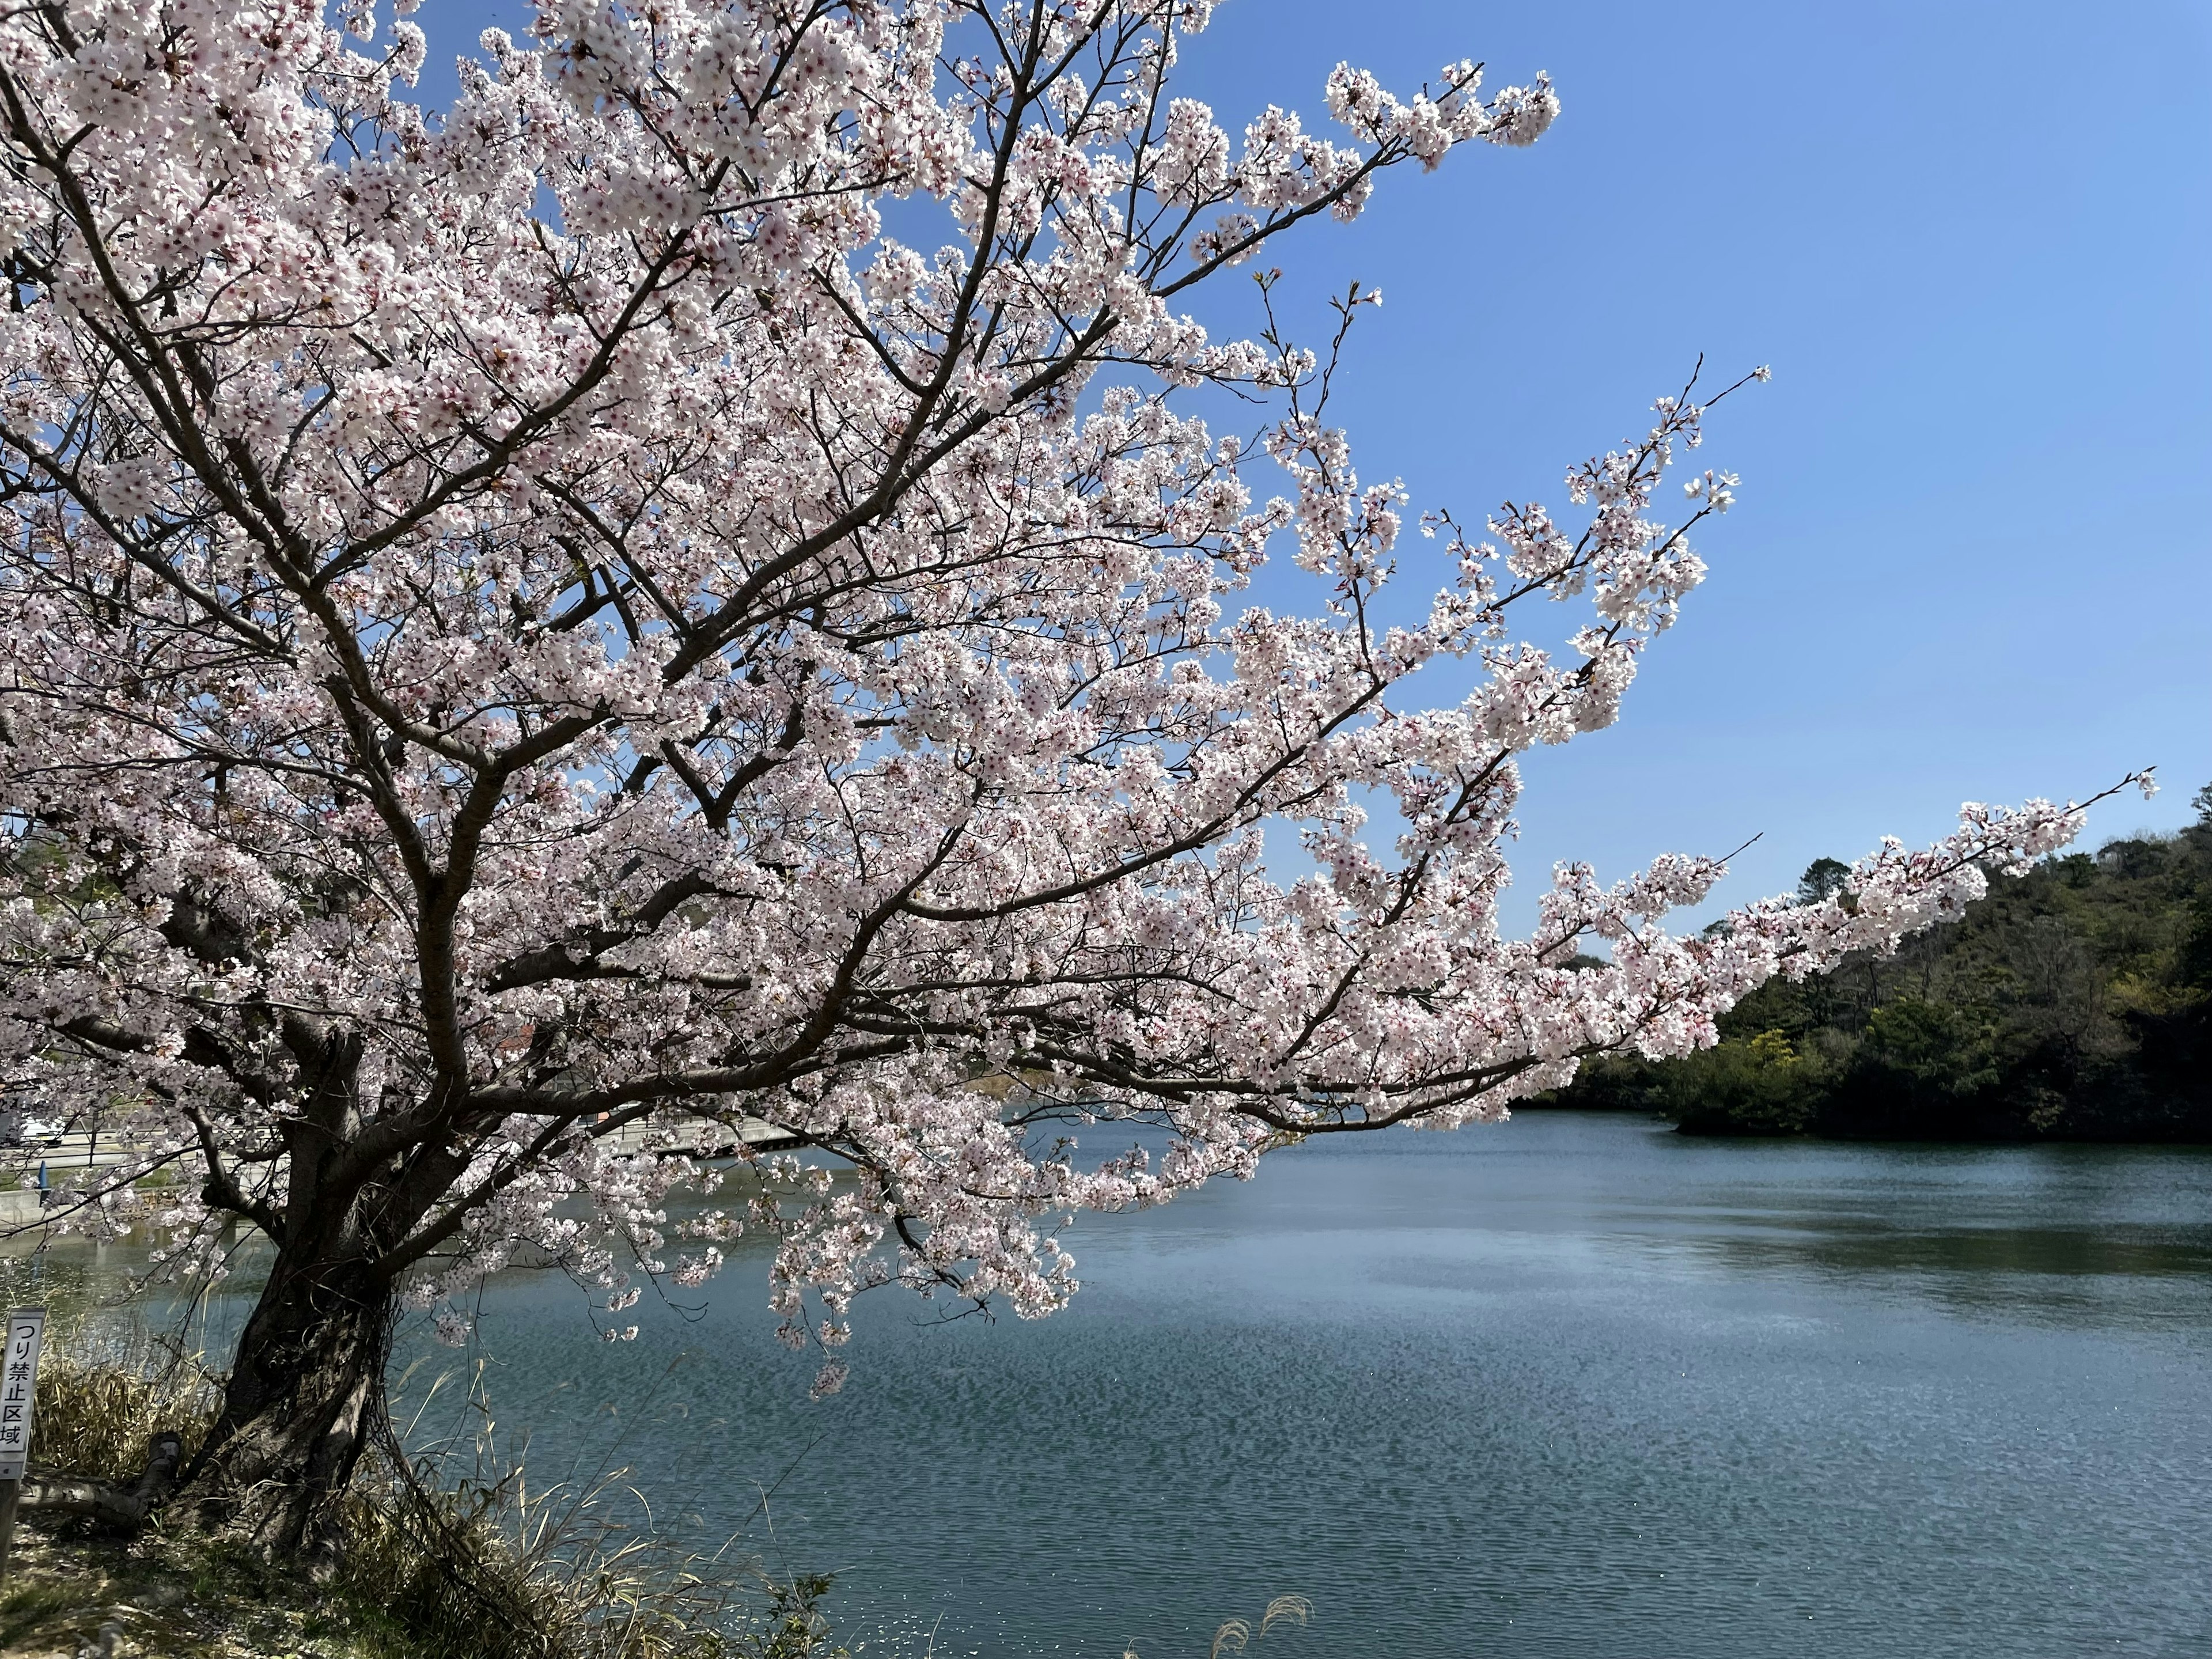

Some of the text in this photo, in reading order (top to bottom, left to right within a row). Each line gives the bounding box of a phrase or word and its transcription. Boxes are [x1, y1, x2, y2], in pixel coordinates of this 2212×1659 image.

[0, 1325, 35, 1444] つり禁止区域
